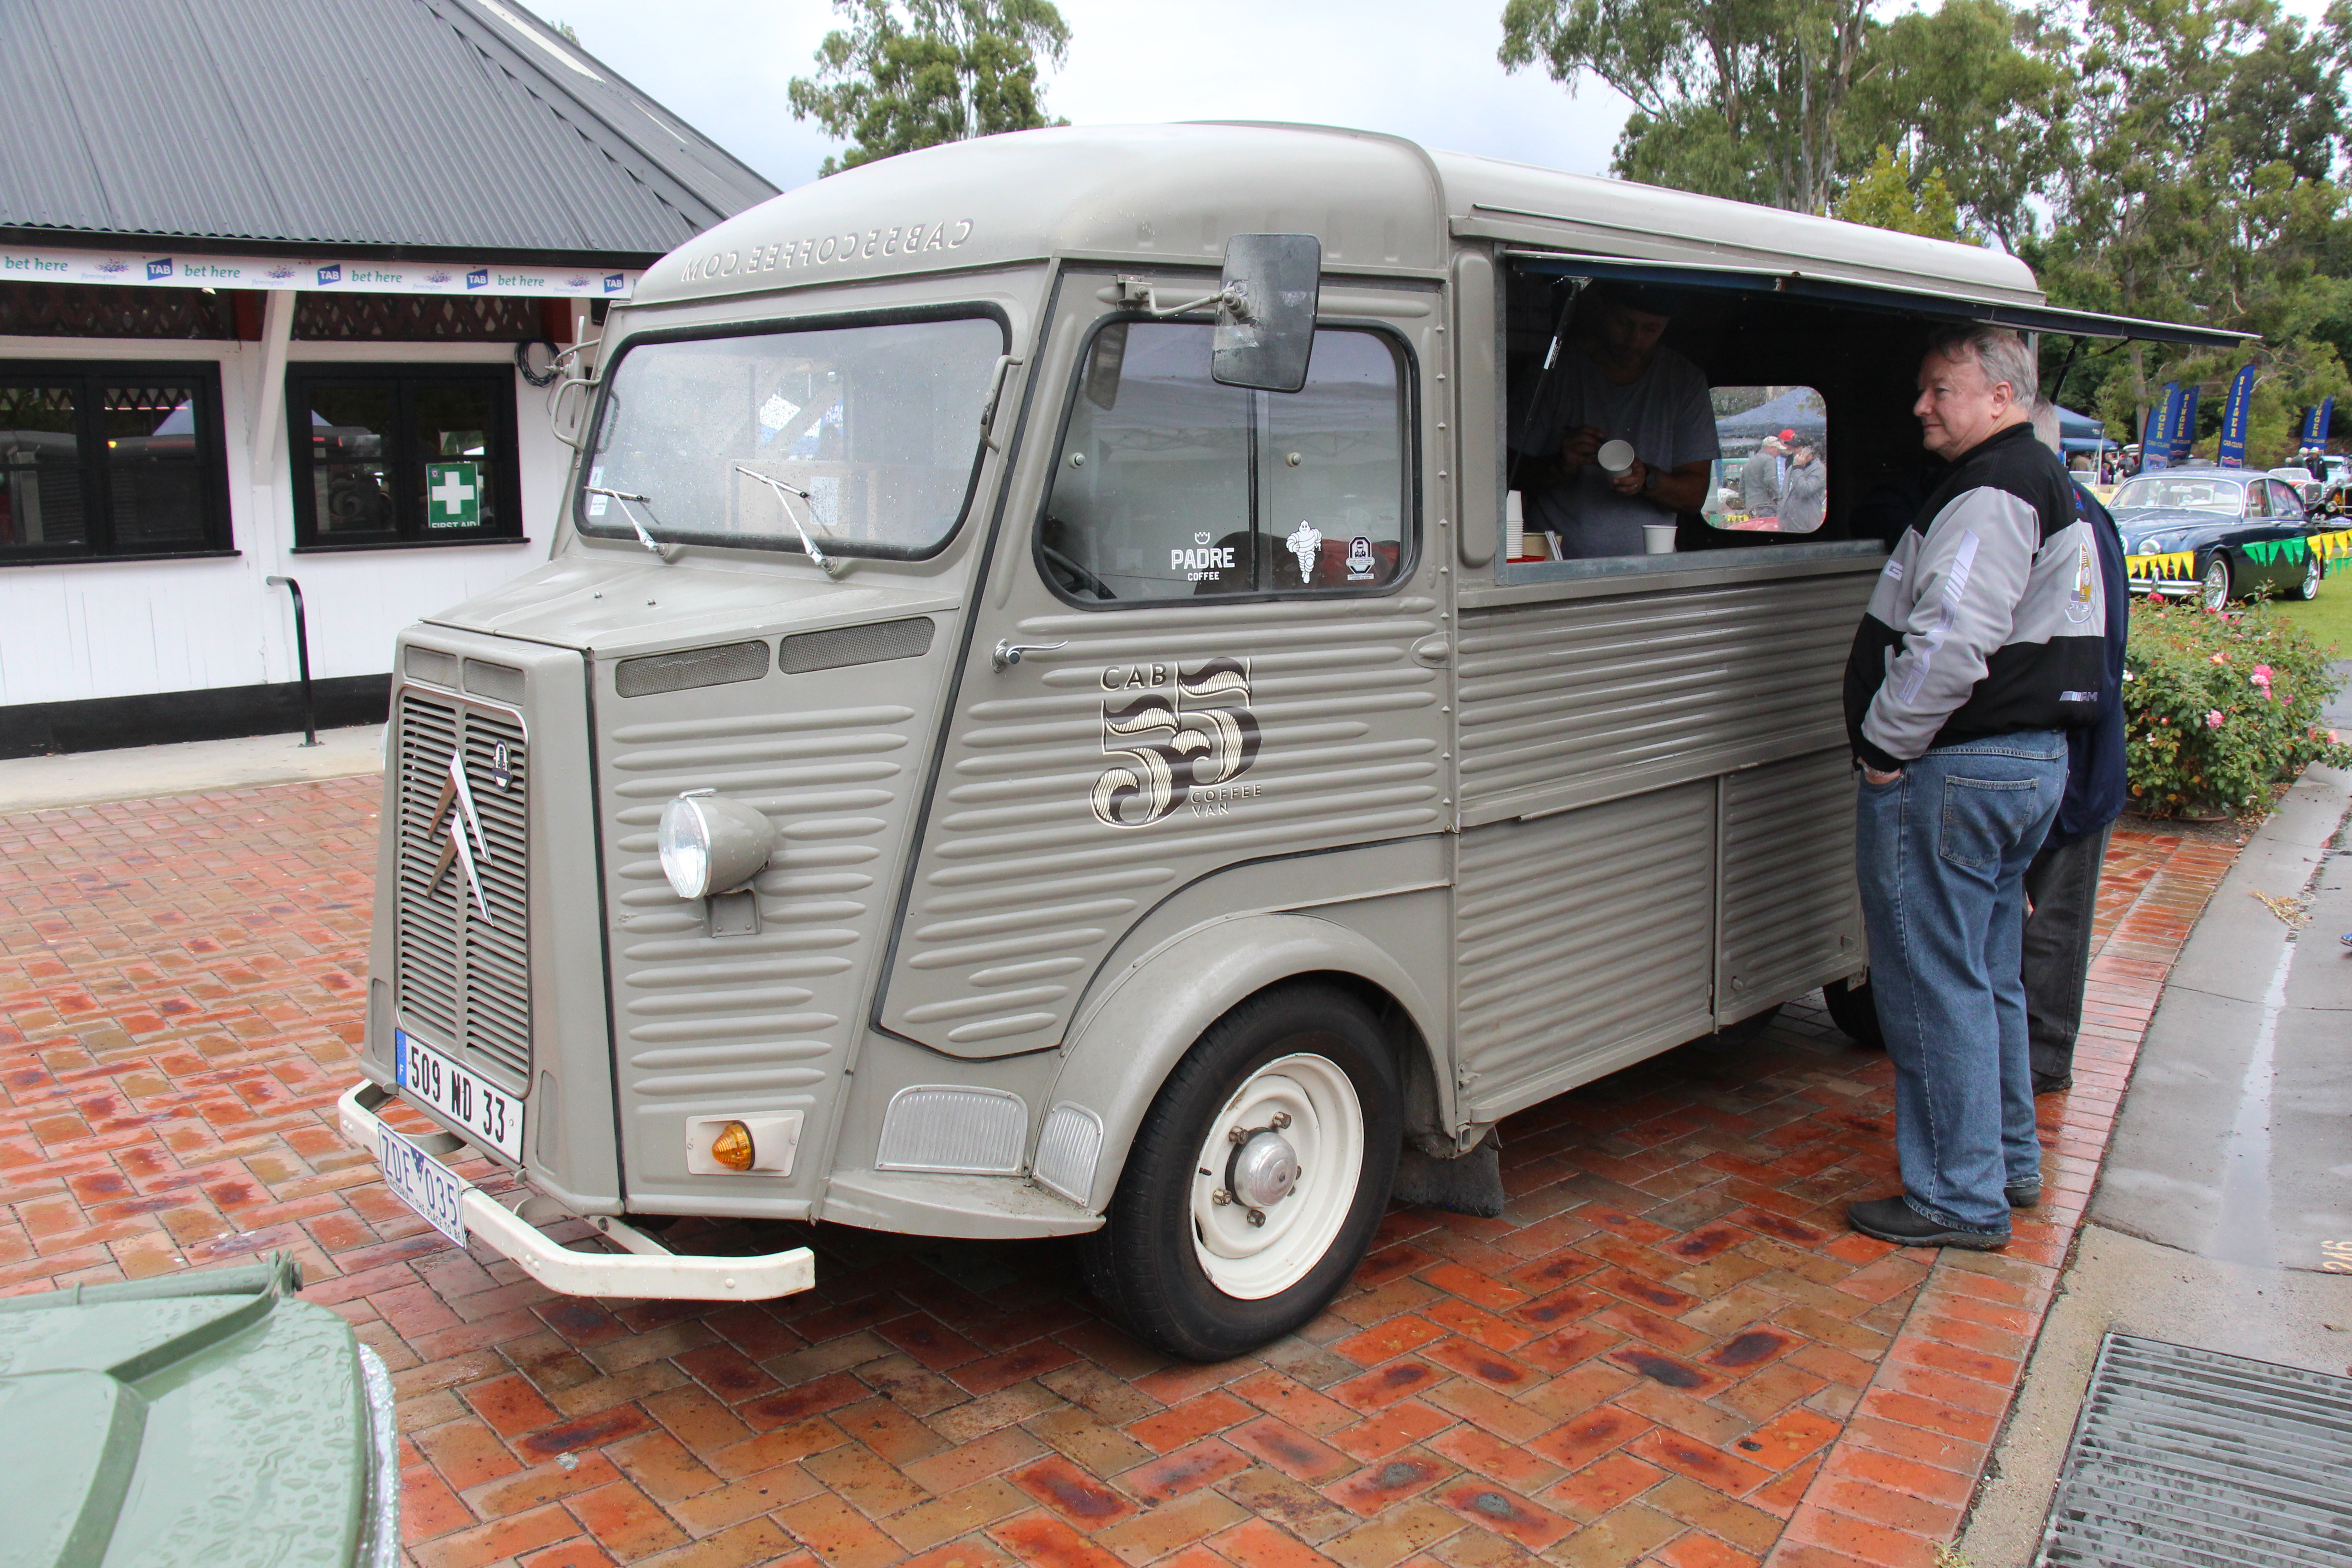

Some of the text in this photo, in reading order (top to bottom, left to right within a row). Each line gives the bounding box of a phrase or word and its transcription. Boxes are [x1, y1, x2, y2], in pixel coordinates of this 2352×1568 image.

[4, 256, 68, 272] bet here
[148, 265, 171, 275] TAB
[184, 264, 240, 278] bet here
[81, 273, 118, 281] flemington
[318, 270, 339, 280] TAB
[351, 270, 402, 283] bet here
[468, 274, 487, 286] TAB
[497, 274, 544, 287] bet here
[605, 279, 622, 288] TAB
[2230, 376, 2246, 437] SINGER
[2177, 394, 2190, 437] SINGER
[1171, 547, 1235, 570] PADRE
[1187, 571, 1220, 581] COFFEE
[1100, 663, 1167, 691] CAB
[1090, 657, 1262, 829] 55
[1191, 784, 1262, 804] COFFEE
[1191, 802, 1229, 818] VAN
[399, 1063, 404, 1075] F
[412, 1045, 505, 1143] 509 ND 33
[425, 1167, 457, 1226] 035
[416, 1198, 425, 1214] THE
[427, 1209, 442, 1228] PLACE
[445, 1221, 452, 1235] TO
[455, 1230, 461, 1242] BE
